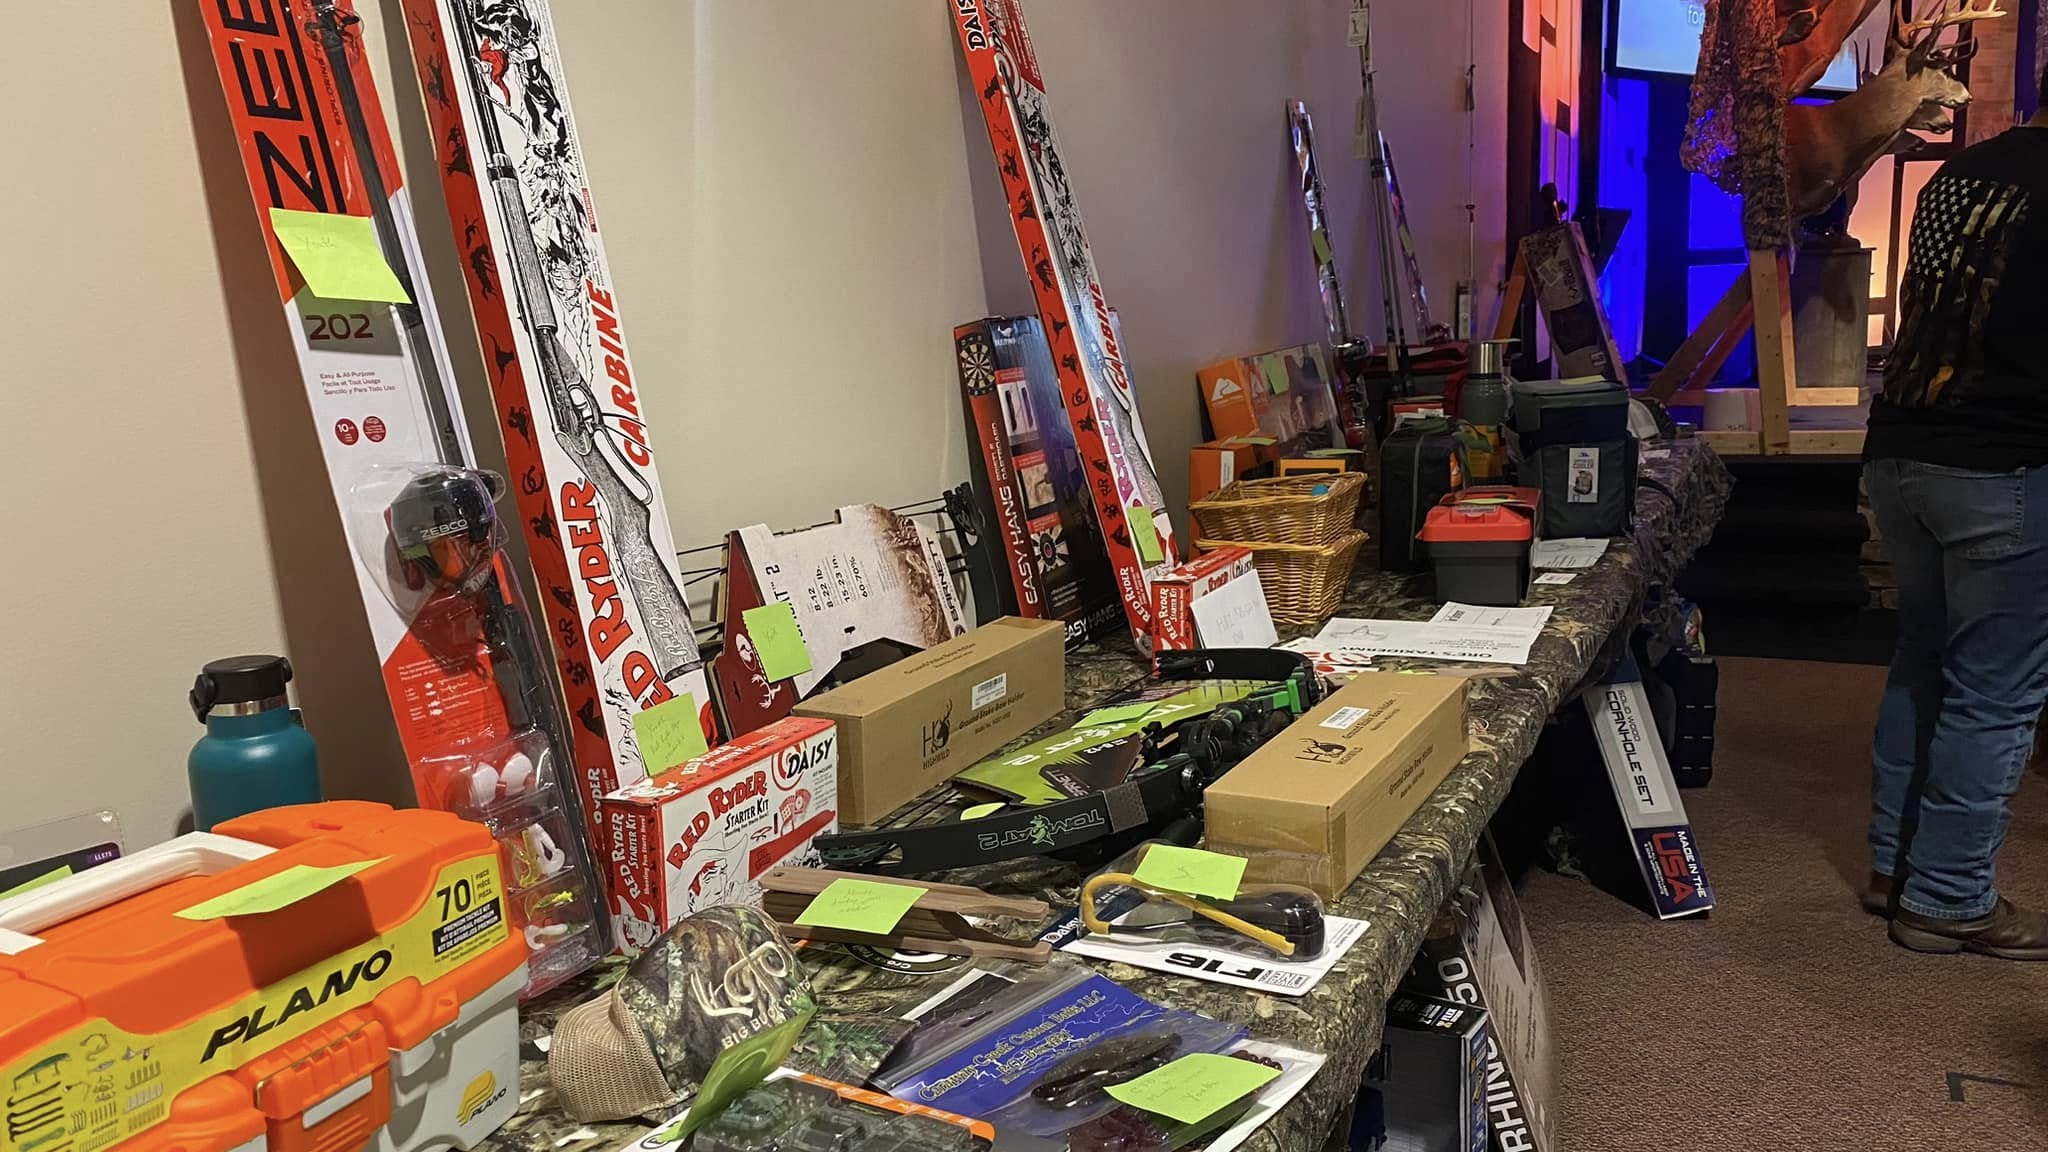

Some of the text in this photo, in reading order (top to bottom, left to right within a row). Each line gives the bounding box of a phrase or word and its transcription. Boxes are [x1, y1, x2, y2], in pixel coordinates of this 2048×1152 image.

[305, 314, 374, 340] 202
[1089, 280, 1128, 391] CARBINE
[585, 280, 650, 468] CARBINE
[338, 423, 349, 433] 10
[1096, 397, 1133, 504] RYDER
[420, 518, 468, 540] ZEBCO
[998, 484, 1039, 604] EASY HANG
[561, 480, 634, 663] RYDER
[835, 571, 850, 603] 15-23
[848, 555, 868, 598] 60-70%
[926, 535, 959, 622] BARNETT
[1117, 566, 1137, 602] RYDER
[807, 586, 821, 612] 8-12
[819, 582, 834, 608] 8-22
[1132, 598, 1152, 623] RED
[1158, 588, 1178, 640] RED RYDER
[1338, 643, 1434, 656] TAXIDERMY
[1617, 690, 1641, 742] SOLID WOOD
[787, 737, 833, 779] DAISY
[1606, 691, 1654, 806] CORNHOLE SET
[667, 811, 711, 870] RED
[708, 770, 768, 820] RYDER
[725, 798, 769, 831] STARTER KIT
[612, 812, 641, 900] RED RYDER
[626, 813, 639, 869] STARTER KIT
[978, 833, 1000, 851] 2
[476, 868, 490, 880] PIECE
[1652, 832, 1696, 905] USA
[1677, 831, 1709, 898] MADE IN THE
[436, 878, 471, 922] 70
[443, 917, 466, 933] PREMIUM
[465, 908, 483, 921] TACKLE
[473, 910, 495, 925] PREMIUM
[1164, 950, 1264, 981] F16
[200, 950, 393, 1065] PLANO
[721, 1024, 750, 1049] BIG
[750, 1003, 783, 1032] BUCK
[470, 1088, 507, 1120] PLANO
